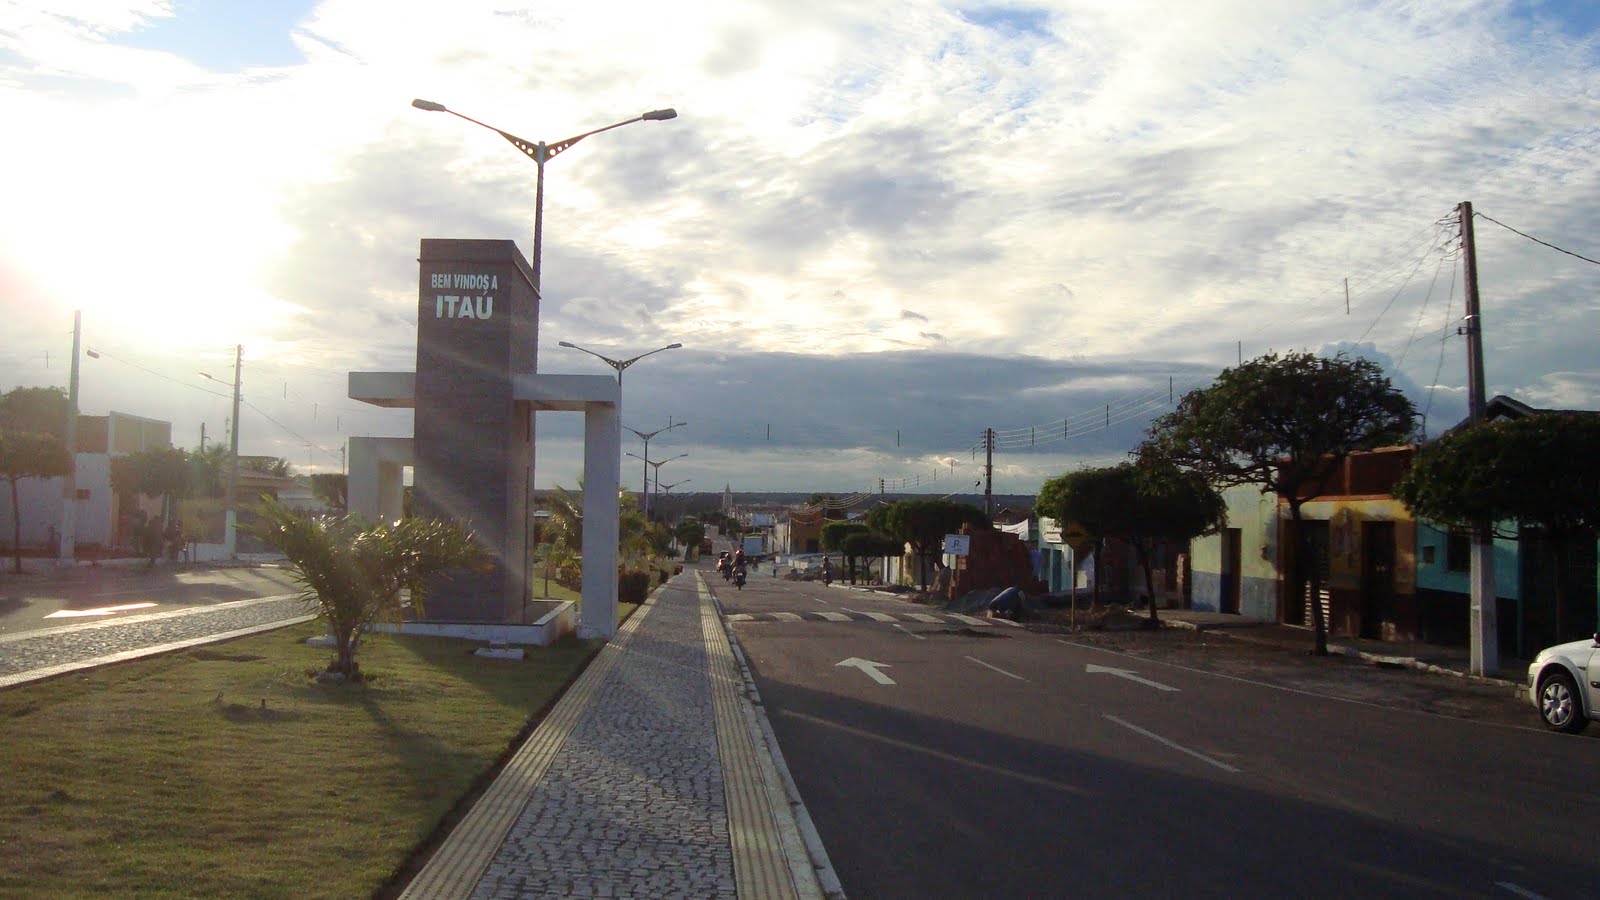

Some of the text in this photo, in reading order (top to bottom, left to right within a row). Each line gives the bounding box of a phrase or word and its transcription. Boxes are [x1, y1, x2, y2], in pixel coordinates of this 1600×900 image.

[431, 273, 498, 290] BEM VINDOS A
[436, 290, 493, 320] ITAÚ
